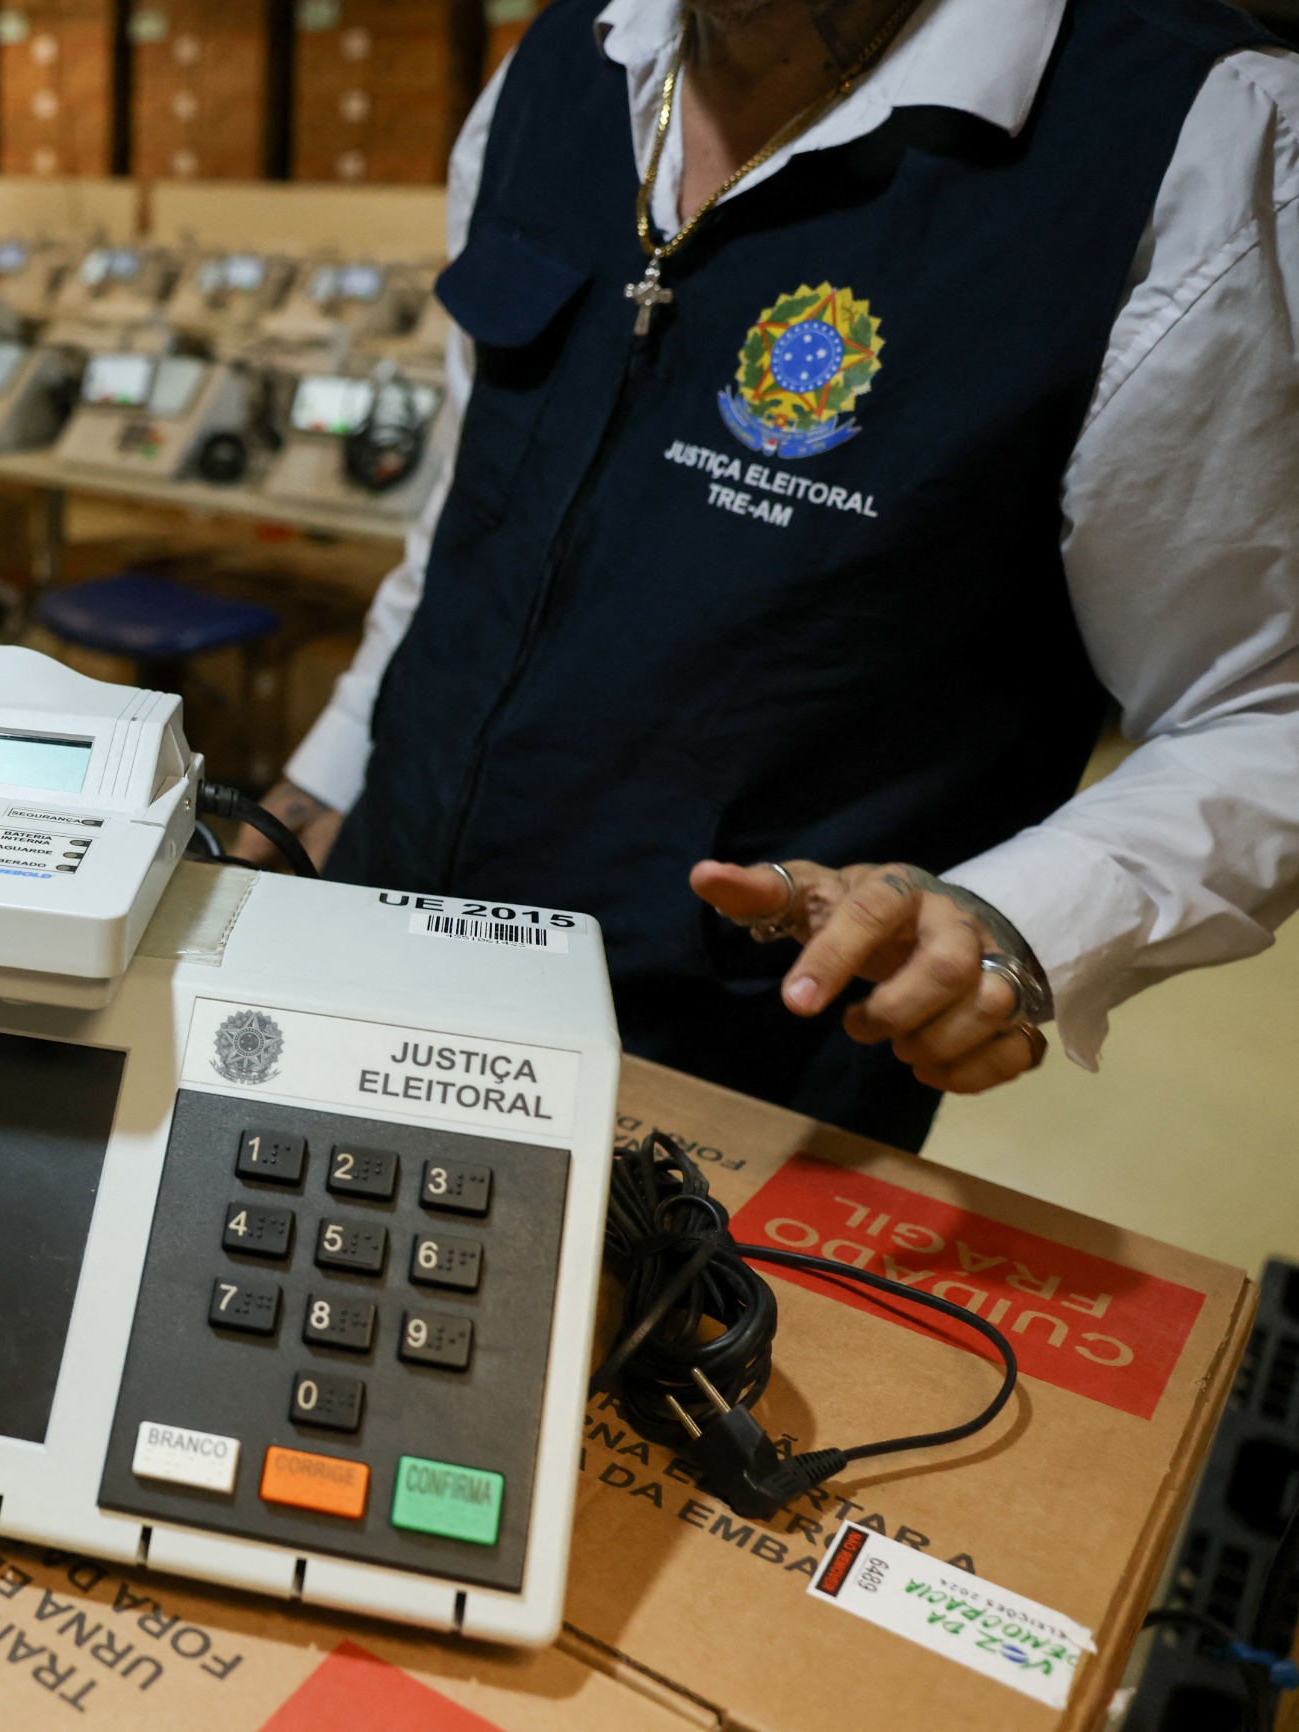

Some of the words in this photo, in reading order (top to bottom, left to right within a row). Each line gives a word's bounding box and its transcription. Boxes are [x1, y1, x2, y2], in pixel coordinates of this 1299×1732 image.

[664, 439, 742, 480] JUSTIÇA
[744, 463, 878, 518] ELEITORAL
[707, 483, 793, 527] TRE-AM
[0, 835, 51, 846] INTERNA
[3, 831, 52, 841] BATERIA
[378, 892, 445, 912] UE
[461, 903, 576, 929] 2015
[390, 1041, 538, 1084] JUSTIÇA
[358, 1069, 553, 1120] ELEITORAL
[248, 1136, 261, 1162] 1
[333, 1153, 354, 1180] 2
[427, 1167, 448, 1194] 3
[228, 1210, 248, 1236] 4
[323, 1224, 344, 1252] 5
[417, 1241, 439, 1269] 6
[833, 1195, 1113, 1319] FRÁGIL
[219, 1283, 239, 1311] 7
[764, 1217, 1134, 1367] CUIDADO
[310, 1301, 331, 1329] 8
[406, 1319, 428, 1348] 9
[297, 1380, 318, 1410] 0
[147, 1427, 230, 1459] BRANCO
[274, 1452, 357, 1487] CORRIGE
[405, 1464, 493, 1506] CONFIRMA
[598, 1462, 664, 1508] DA
[857, 1557, 890, 1594] 6489
[939, 1577, 981, 1601] 2024
[111, 1582, 243, 1681] FORA
[926, 1610, 966, 1635] DA
[34, 1589, 163, 1691] URNA
